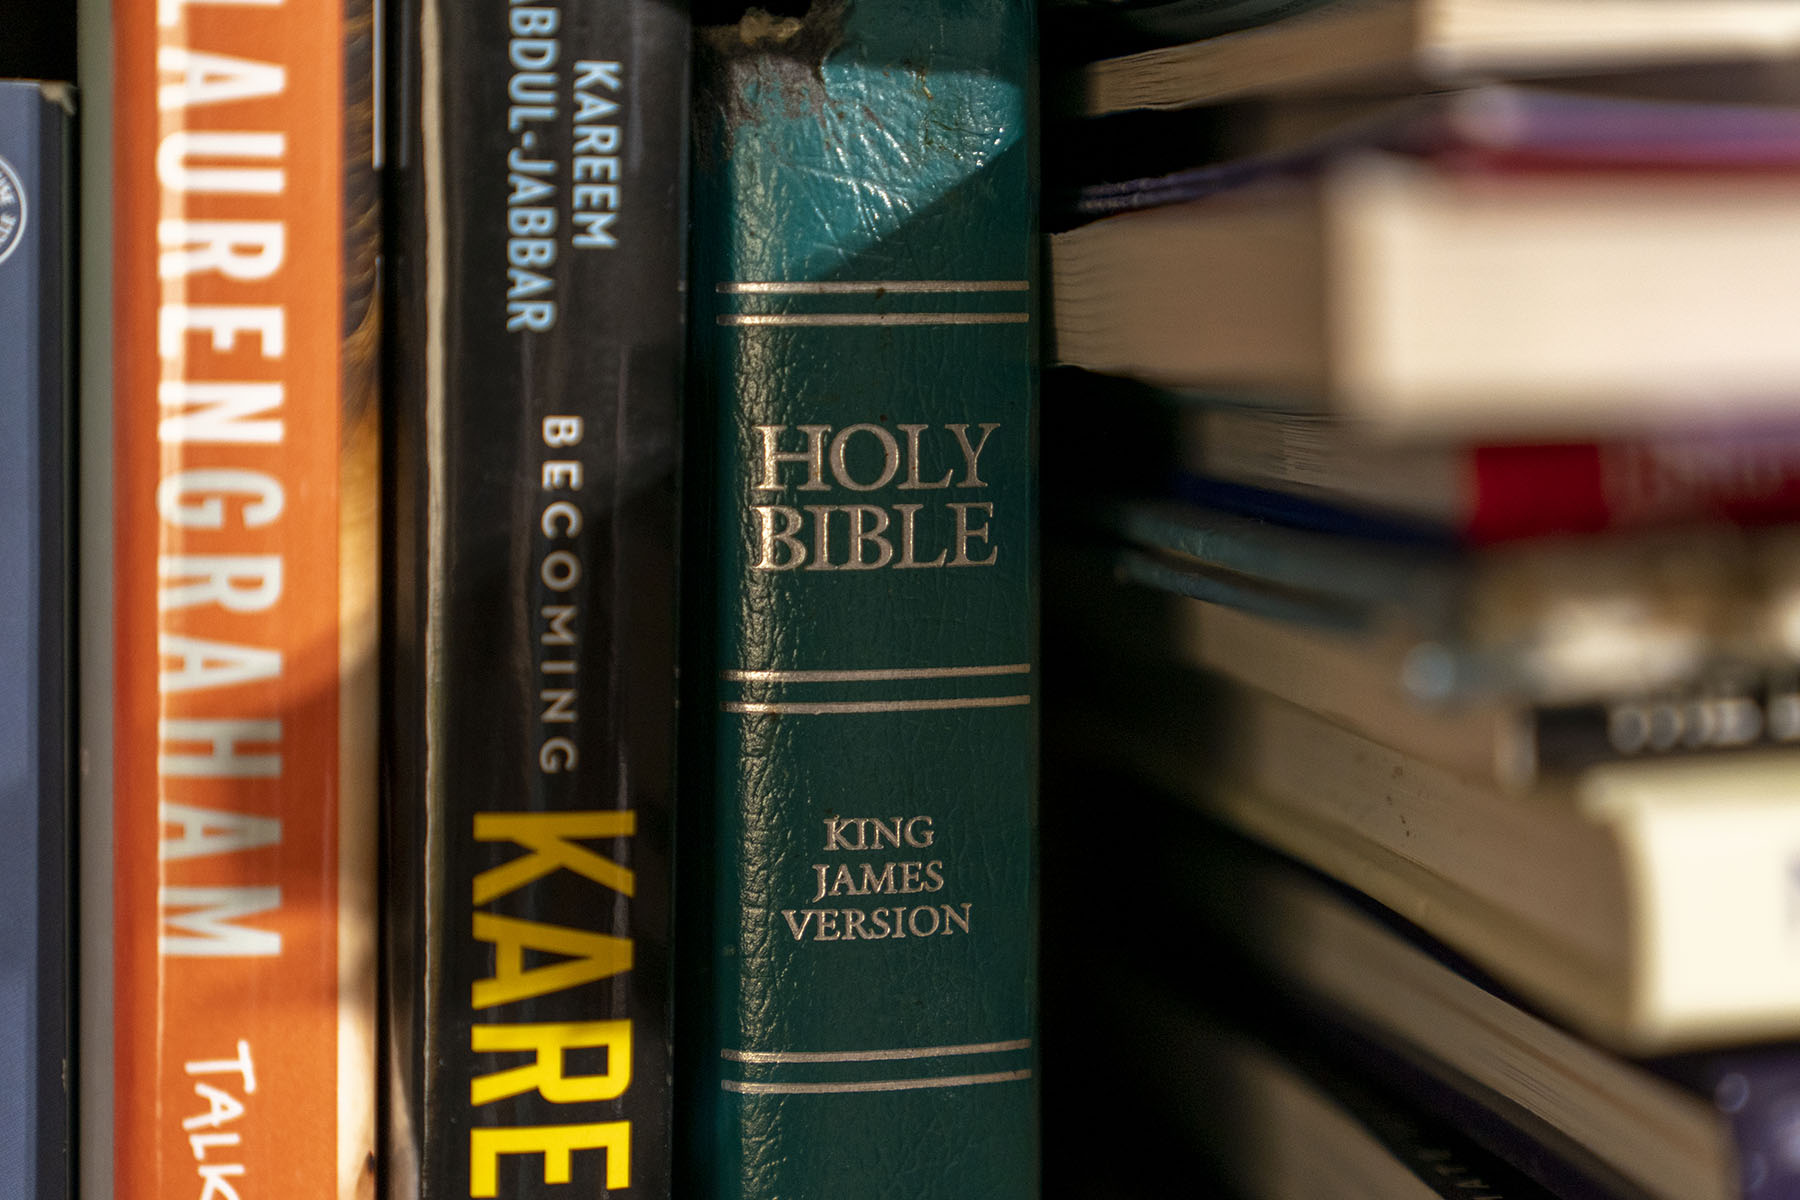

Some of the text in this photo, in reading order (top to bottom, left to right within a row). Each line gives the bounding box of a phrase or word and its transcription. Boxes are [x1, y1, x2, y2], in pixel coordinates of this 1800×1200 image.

[571, 60, 624, 250] KAREEM
[751, 422, 1001, 491] HOLY
[748, 501, 999, 571] BIBLE
[539, 414, 584, 775] BECOMING
[822, 815, 935, 852] KING
[812, 860, 945, 903] JAMES
[781, 902, 974, 942] VERSION
[470, 809, 637, 1198] KARE
[183, 1039, 257, 1200] TALK
